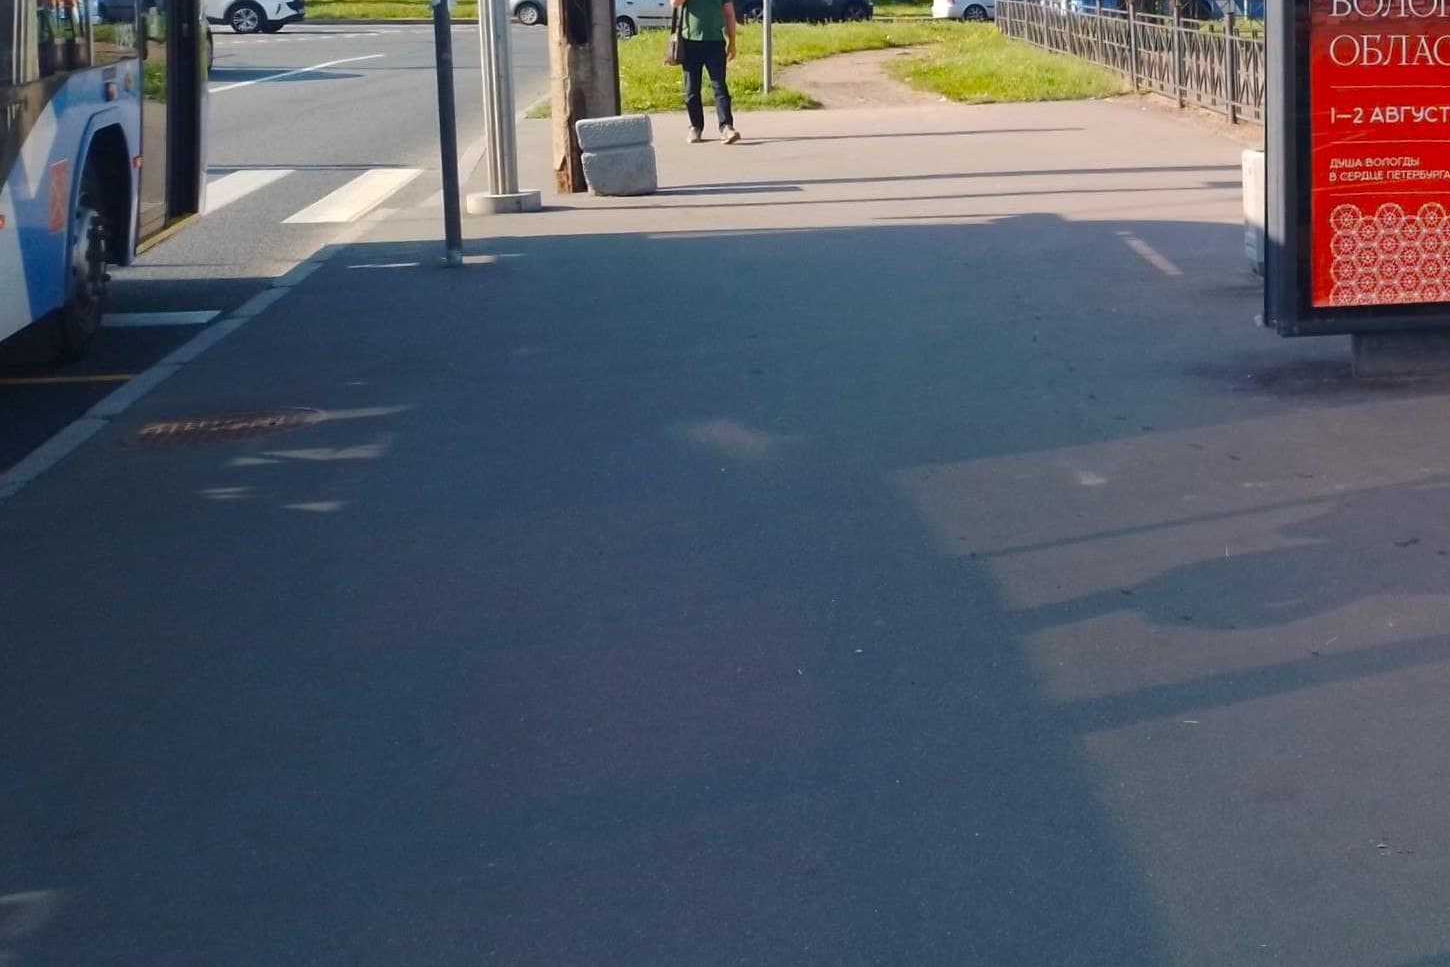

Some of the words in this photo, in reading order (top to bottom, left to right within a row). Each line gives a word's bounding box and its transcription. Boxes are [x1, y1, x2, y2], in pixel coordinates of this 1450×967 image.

[1330, 158, 1363, 169] ДУША
[1365, 156, 1420, 168] ВОЛОГДЫ
[1329, 171, 1337, 182] В
[1340, 170, 1384, 181] СЕРДЦЕ
